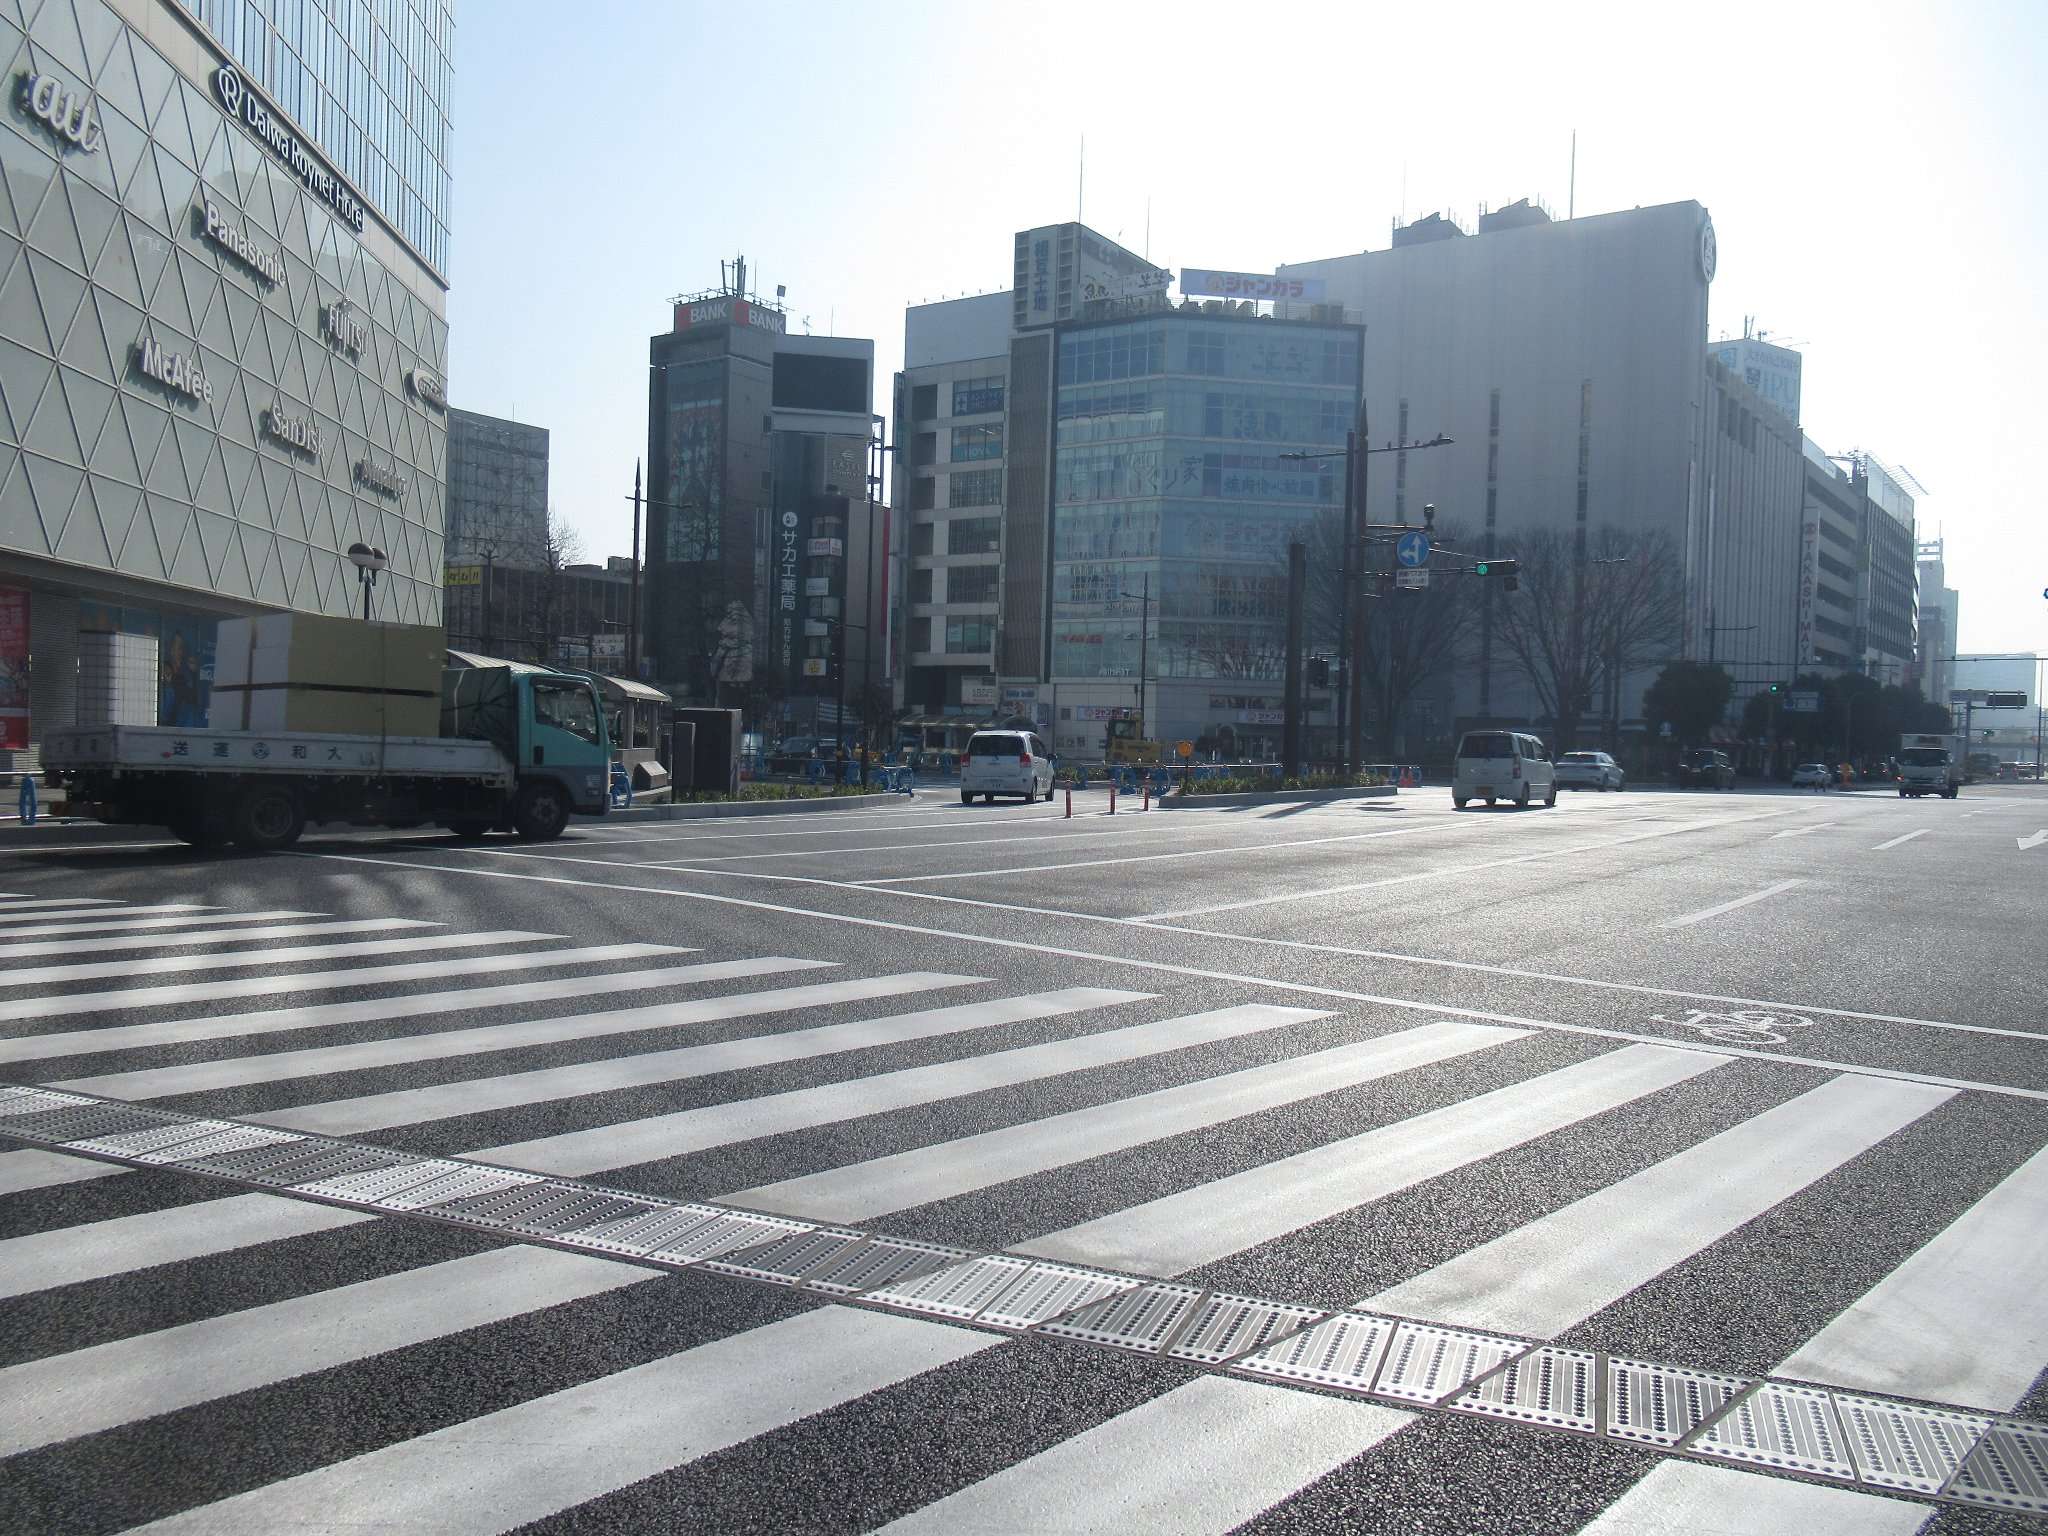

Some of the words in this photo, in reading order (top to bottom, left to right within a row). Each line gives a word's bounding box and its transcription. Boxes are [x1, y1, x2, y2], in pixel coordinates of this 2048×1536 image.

[31, 74, 101, 152] au
[246, 94, 291, 159] Daiwa
[291, 141, 337, 206] Roynet
[336, 185, 365, 233] Hotel
[205, 200, 288, 288] Panasonic
[689, 303, 727, 323] BANK
[748, 310, 784, 334] BANK
[142, 337, 214, 404] McAfee
[270, 403, 326, 457] SanDisk
[780, 530, 798, 611] サカエ薬局
[1799, 539, 1814, 665] TAKASHIMAYA
